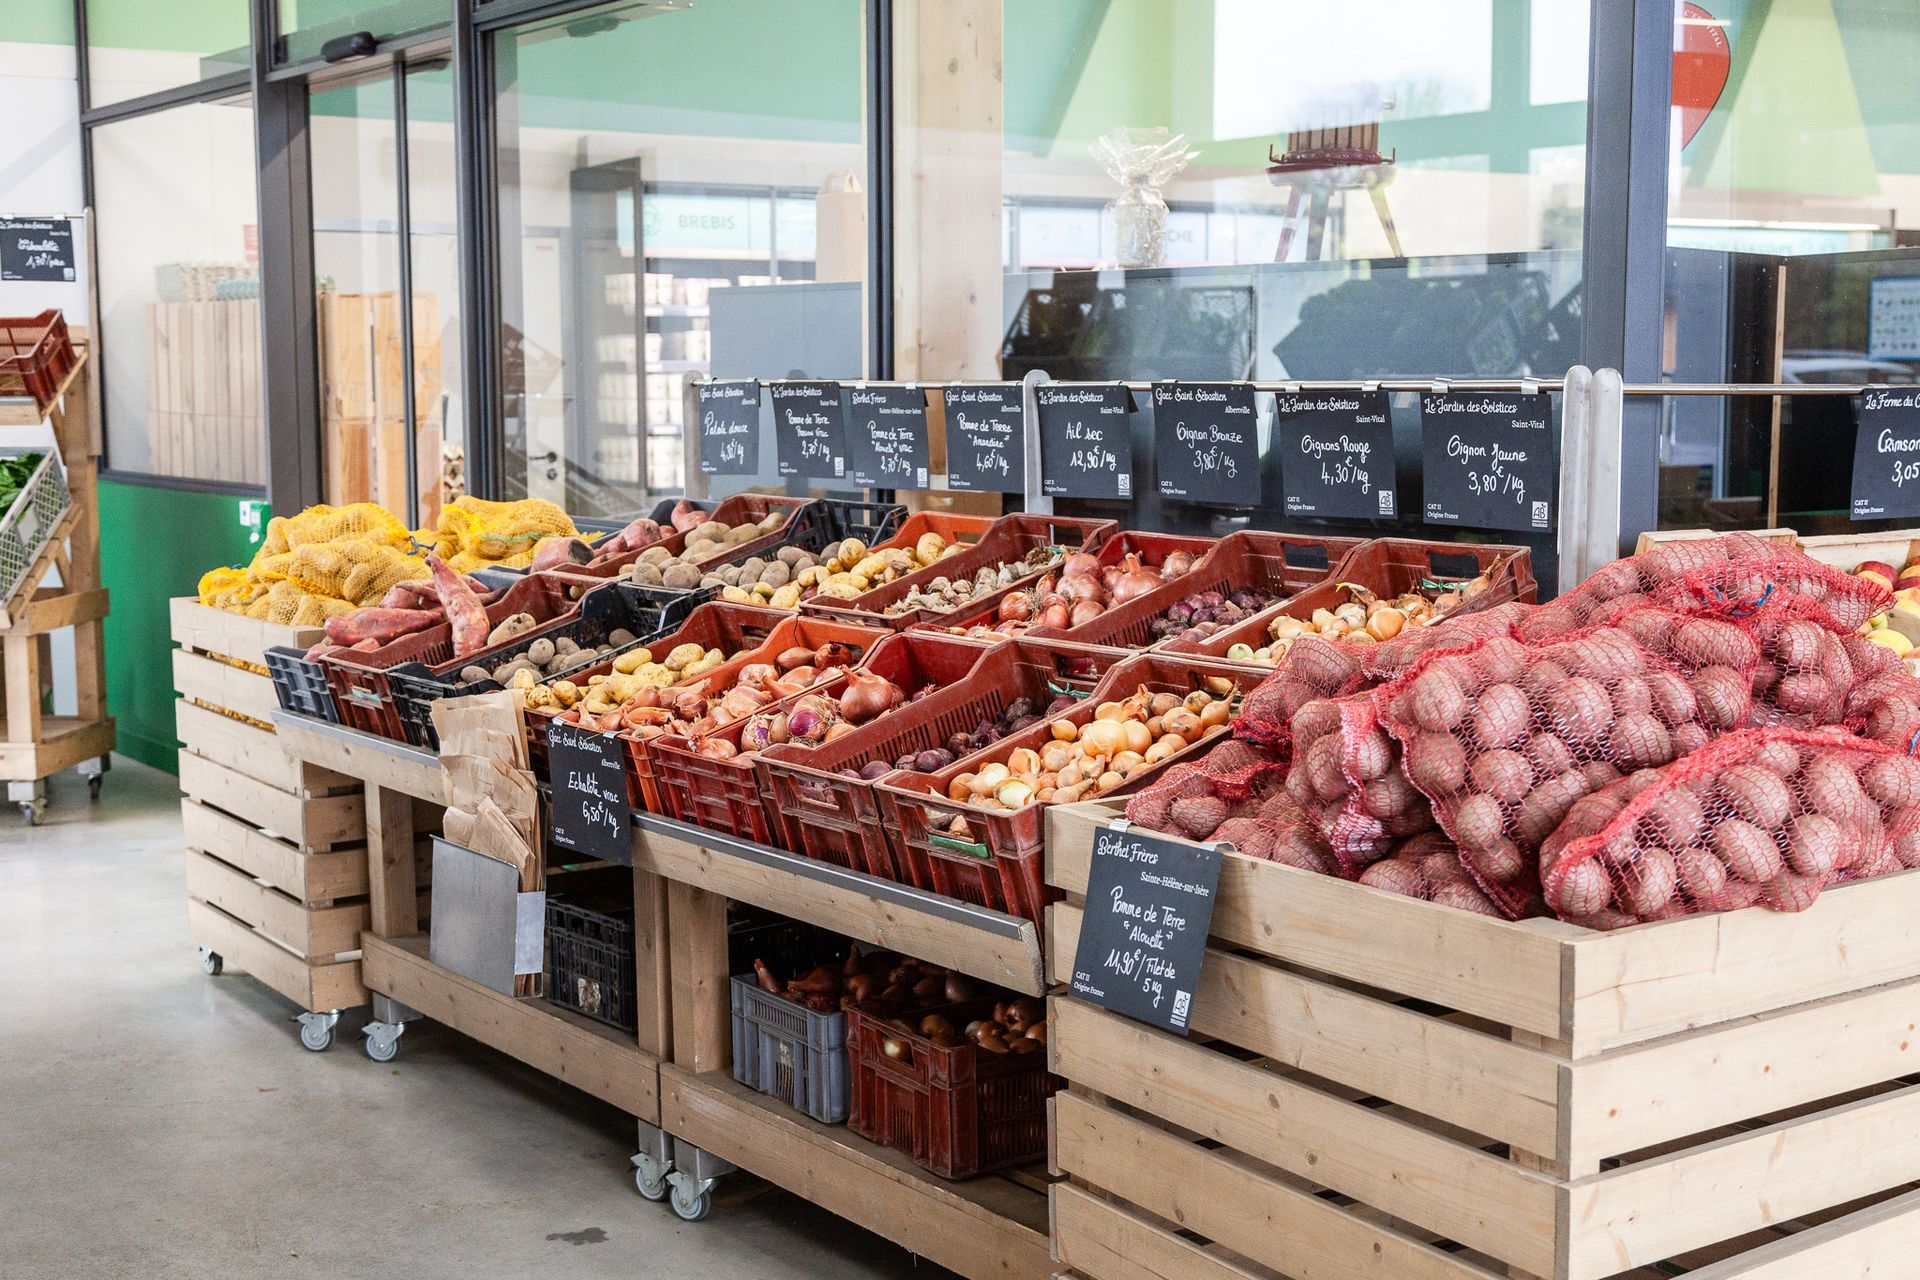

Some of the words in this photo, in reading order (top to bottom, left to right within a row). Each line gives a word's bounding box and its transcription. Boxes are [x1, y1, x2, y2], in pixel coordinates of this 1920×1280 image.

[678, 214, 736, 230] BREBIS
[946, 390, 960, 406] Gaec
[961, 390, 976, 402] Saint
[1039, 392, 1048, 405] Le
[1048, 391, 1068, 404] Jardin
[1069, 393, 1078, 403] des
[1079, 390, 1104, 404] Solstices
[1155, 388, 1173, 406] Gaec
[1175, 388, 1193, 402] Saint
[1195, 389, 1227, 402] Sébastien
[1280, 398, 1290, 412] Le
[1290, 398, 1316, 412] Jardin
[1317, 400, 1328, 410] des
[1328, 397, 1360, 411] Solstices
[1424, 398, 1436, 414] Le
[1436, 399, 1465, 414] Jardin
[1467, 402, 1480, 412] des
[1480, 399, 1517, 414] Solstices
[1865, 394, 1876, 410] La
[1877, 394, 1903, 409] Ferme
[1903, 396, 1913, 406] du
[786, 408, 804, 424] Pomme
[805, 414, 812, 424] de
[813, 413, 830, 424] Terre
[1225, 406, 1250, 414] Albertville
[1356, 415, 1385, 423] Saint-Vital
[704, 411, 727, 436] Patate
[729, 421, 748, 434] douce
[868, 420, 888, 440] Pomme
[889, 427, 897, 440] de
[897, 428, 914, 440] Terre
[957, 412, 978, 430] Pomme
[980, 419, 989, 432] de
[1066, 422, 1082, 440] Ail
[1084, 428, 1103, 441] sec
[1512, 420, 1545, 428] Saint-Vital
[1176, 422, 1208, 448] Oignon
[1209, 424, 1243, 443] Bronze
[802, 439, 831, 462] 2,70€/kg
[1070, 445, 1117, 472] 12,90€/kg
[1301, 435, 1340, 459] Oignons
[1340, 435, 1371, 464] Rouge
[1447, 435, 1486, 464] Oignon
[1492, 443, 1527, 470] Jaune
[881, 453, 912, 476] 2,70€/kg
[976, 449, 1010, 477] 4,60€/kg
[1193, 446, 1238, 478] 3,80€/kg
[1321, 456, 1371, 494] 4,30€/kg
[1892, 460, 1920, 487] 3,05
[1468, 466, 1525, 504] 3,80€/kg
[549, 729, 562, 748] Gaec
[563, 733, 577, 748] Saint
[568, 772, 601, 797] Echalote
[603, 790, 619, 803] vrac
[583, 801, 620, 839] 6,50€/kg
[1097, 836, 1129, 858] Berthet
[1129, 844, 1159, 864] Frères
[1140, 872, 1209, 897] Sainte-Hélène-sur-Isère
[1110, 885, 1141, 918] Pomme
[1144, 904, 1157, 923] de
[1162, 906, 1186, 930] Terre
[1076, 972, 1085, 980] CAT
[1143, 978, 1152, 992] 5
[1074, 982, 1091, 993] Origine
[1090, 987, 1104, 997] France
